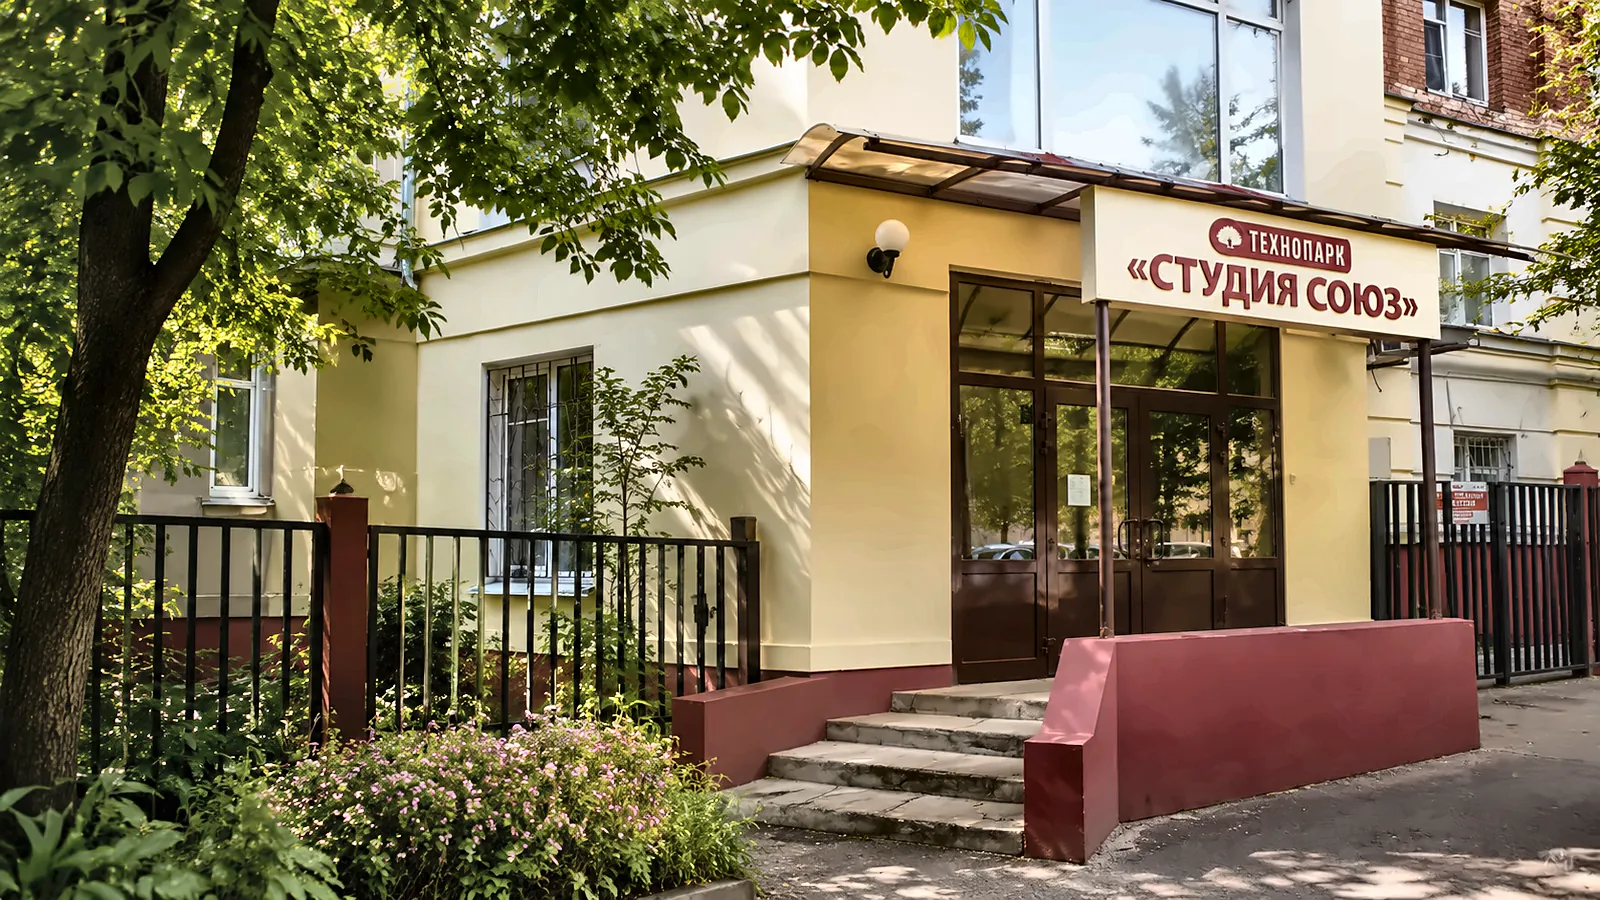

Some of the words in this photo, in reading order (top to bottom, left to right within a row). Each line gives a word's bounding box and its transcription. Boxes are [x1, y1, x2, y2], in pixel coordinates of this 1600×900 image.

[1249, 230, 1345, 266] ТЕХНОПАРК
[1127, 254, 1298, 309] «СТУДИЯ
[1307, 277, 1418, 320] СОЮЗ»
